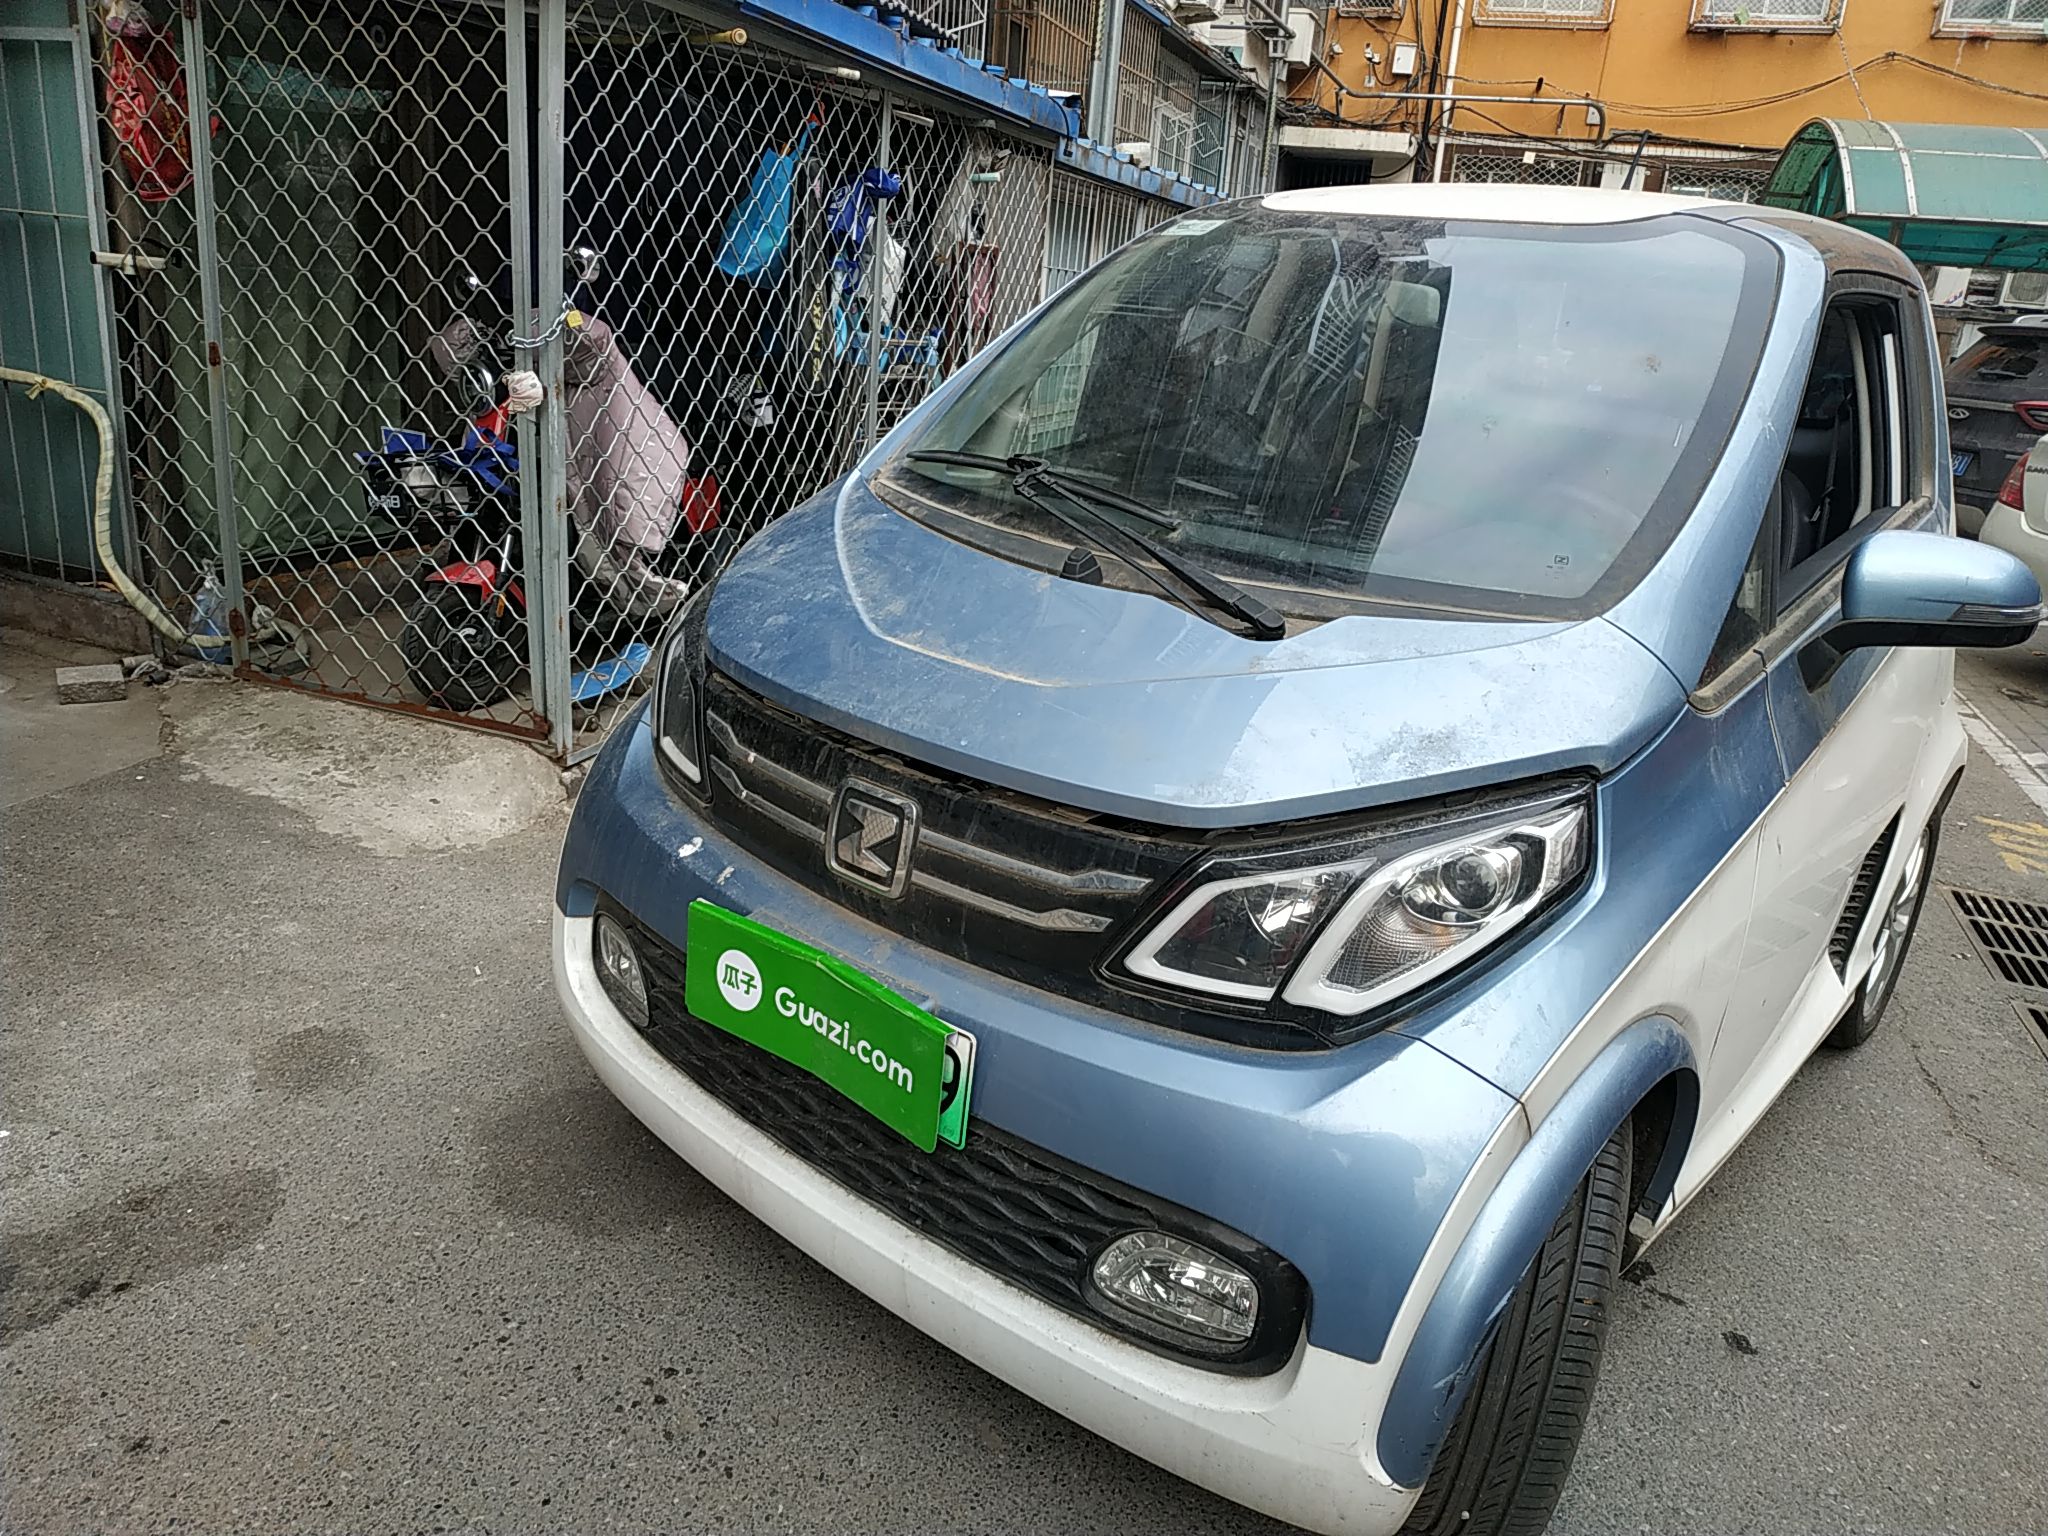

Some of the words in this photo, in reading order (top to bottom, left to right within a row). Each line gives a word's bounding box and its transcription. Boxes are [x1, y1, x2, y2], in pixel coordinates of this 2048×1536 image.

[1952, 454, 1968, 472] 81
[722, 964, 757, 995] 瓜子
[775, 987, 913, 1093] Guazi.com
